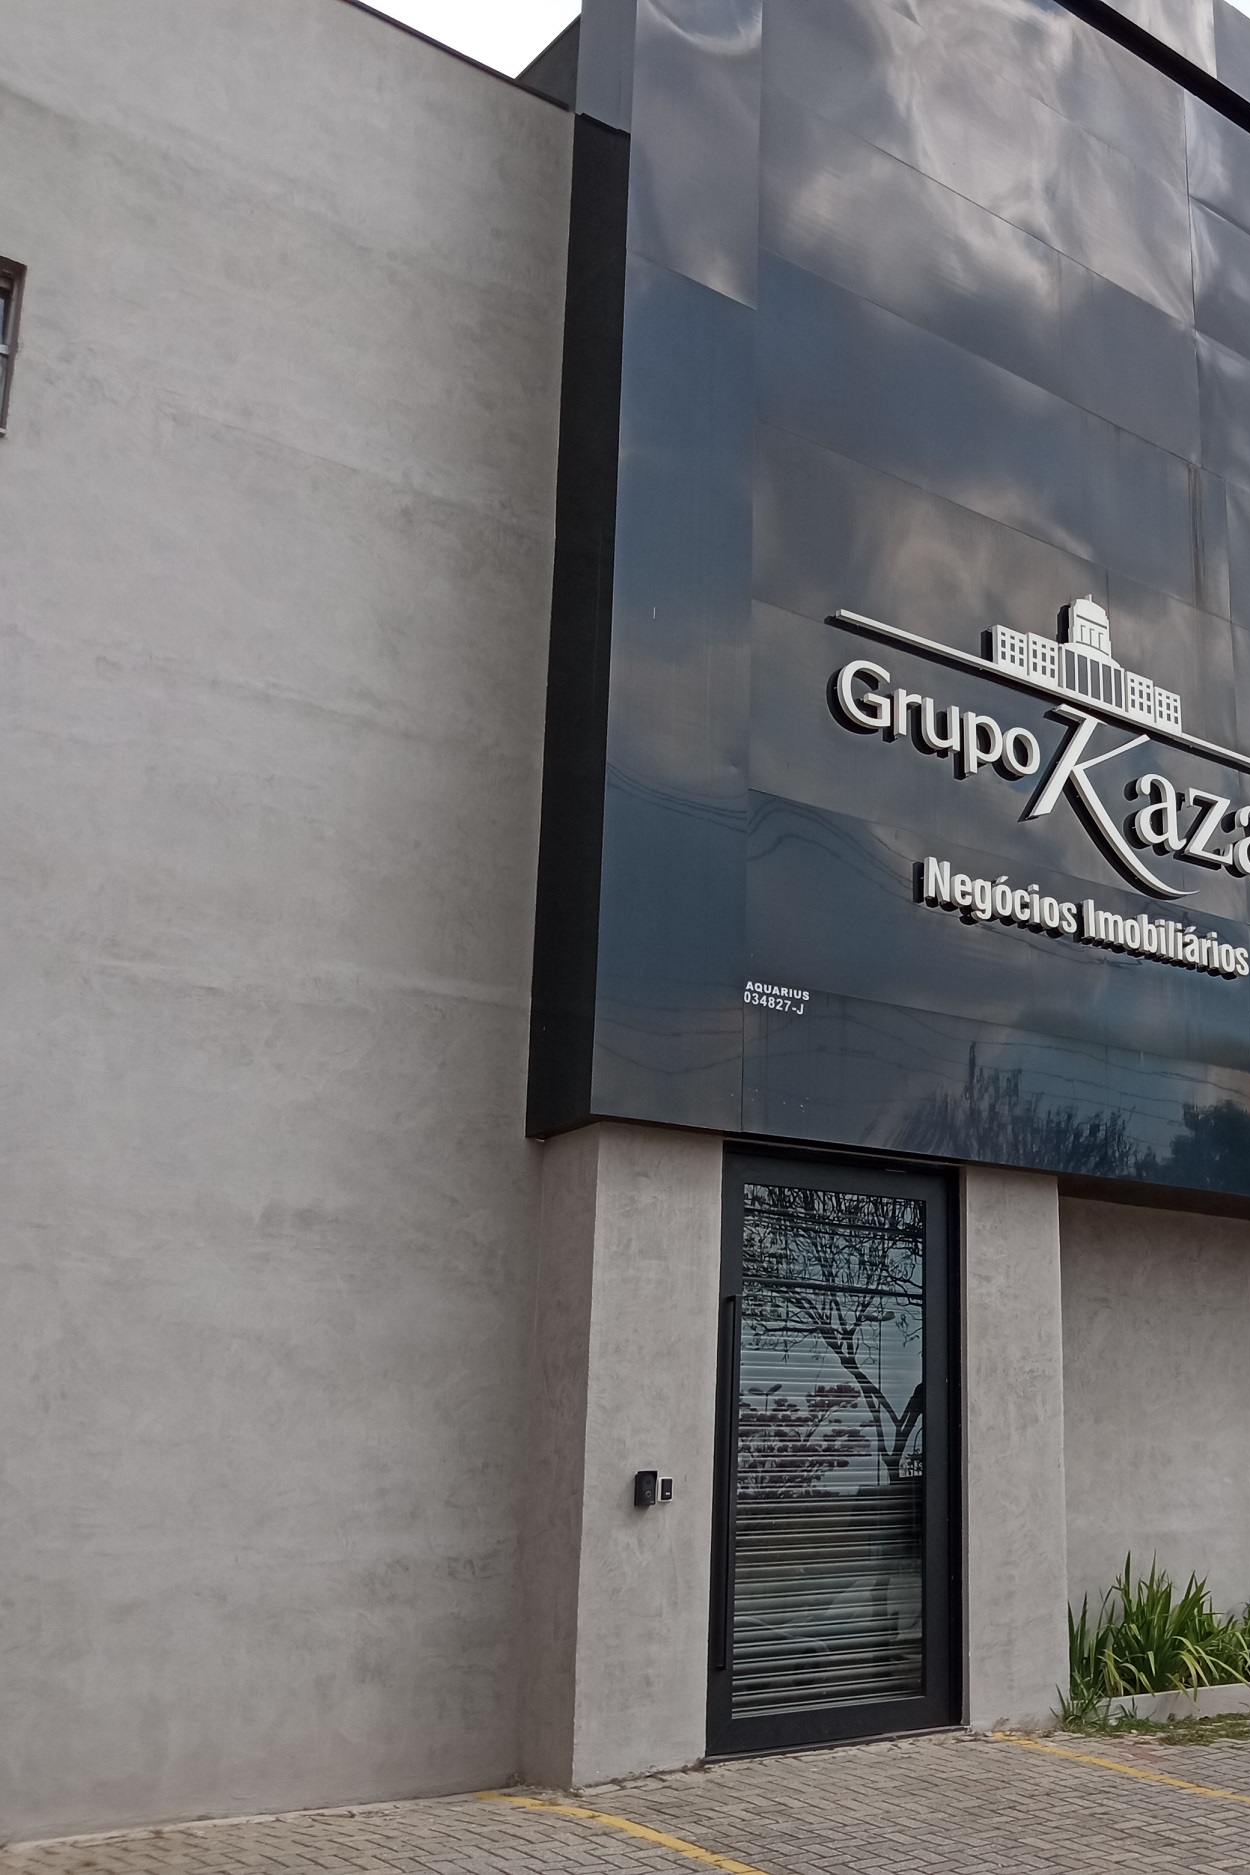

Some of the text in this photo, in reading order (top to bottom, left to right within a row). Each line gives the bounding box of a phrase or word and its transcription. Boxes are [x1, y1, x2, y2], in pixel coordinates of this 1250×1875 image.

[831, 659, 1041, 778] Grupo
[921, 856, 1250, 978] Negócios Imobiliários
[743, 991, 804, 1015] 034827-J
[745, 981, 810, 1001] AQUARIUS
